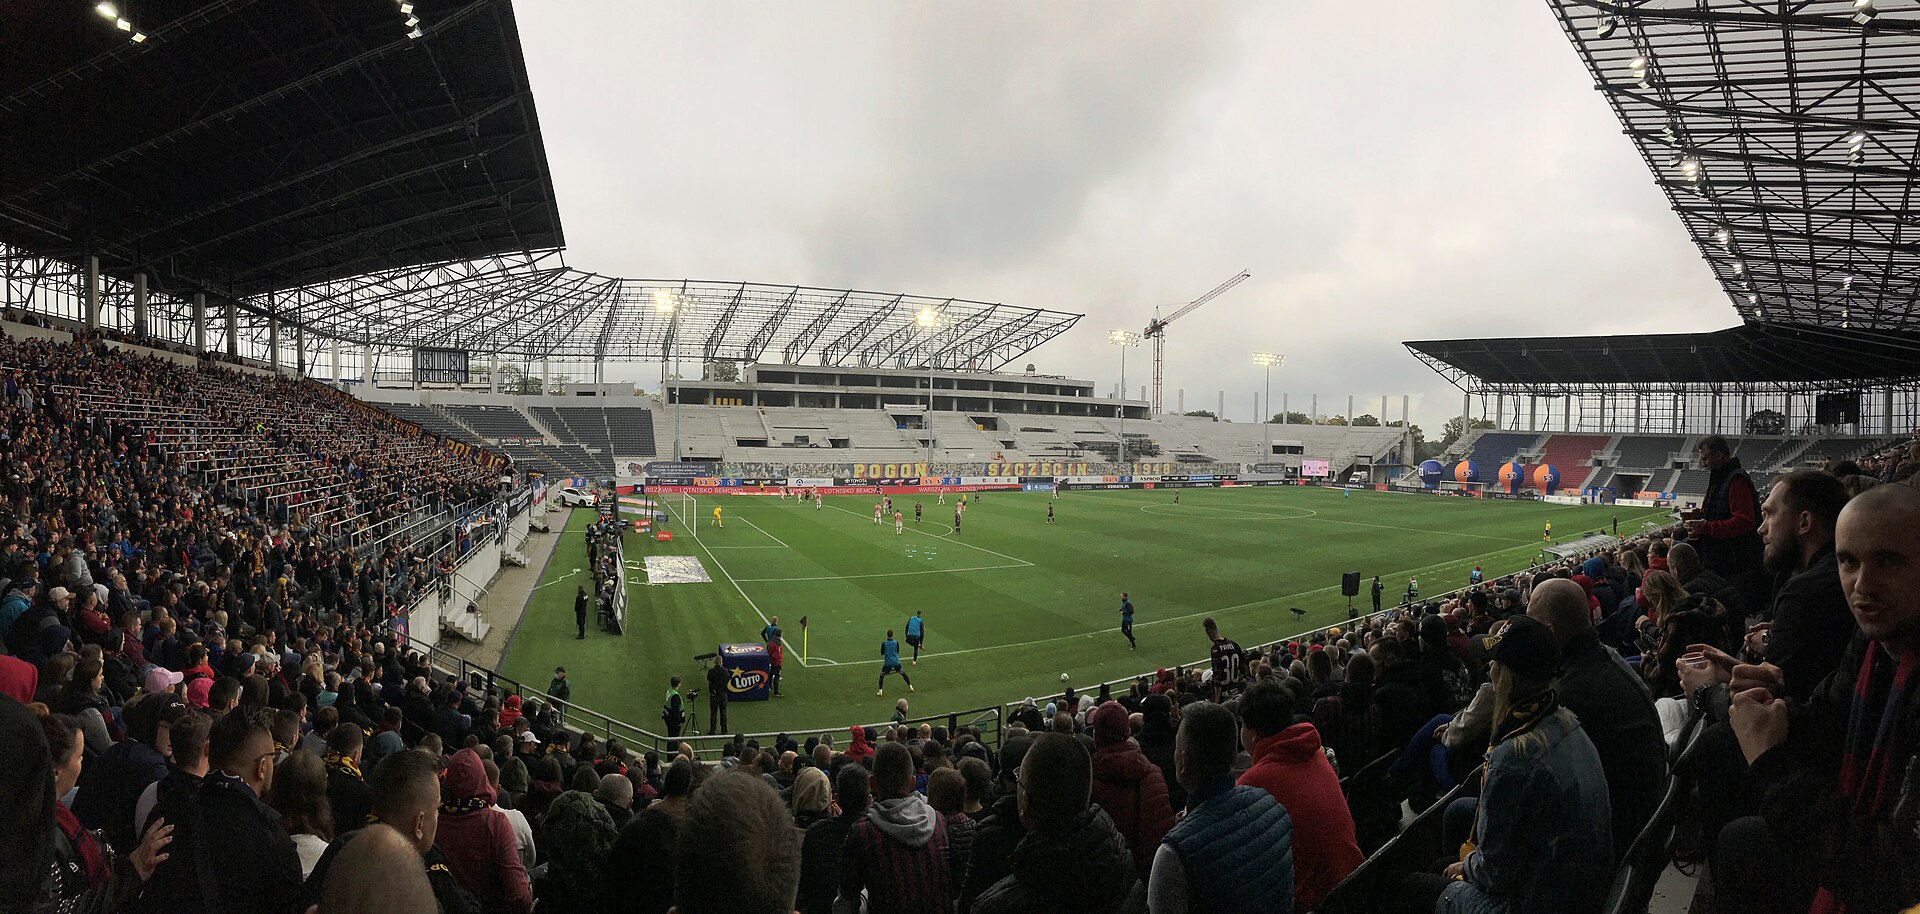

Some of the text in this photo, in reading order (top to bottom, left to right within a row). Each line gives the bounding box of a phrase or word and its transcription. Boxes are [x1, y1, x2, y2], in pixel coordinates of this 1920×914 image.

[987, 462, 1088, 477] SZCZECIN
[1133, 463, 1172, 477] 1948
[714, 486, 744, 494] BEMOWO
[1220, 653, 1240, 685] 30
[735, 673, 761, 689] LOTTO
